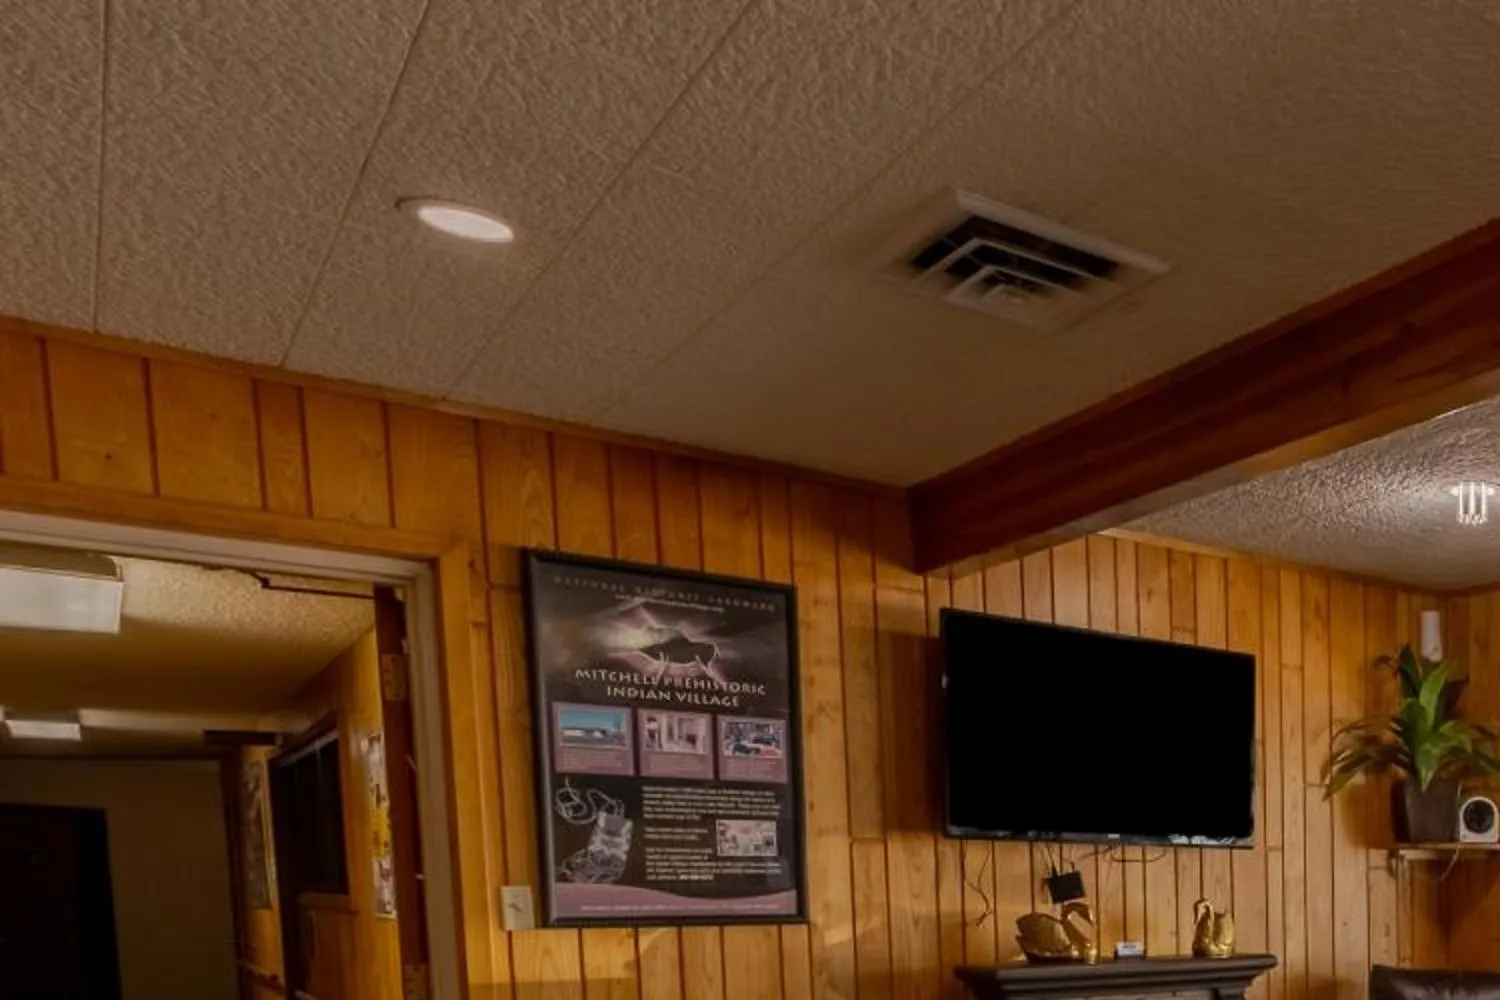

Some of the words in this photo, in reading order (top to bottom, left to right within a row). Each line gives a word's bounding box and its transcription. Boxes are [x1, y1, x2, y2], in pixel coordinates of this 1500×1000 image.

[575, 668, 657, 686] MITCHELL
[664, 673, 766, 695] PREHISTORIC
[607, 685, 670, 701] INDIAN
[676, 691, 740, 708] VILLAGE
